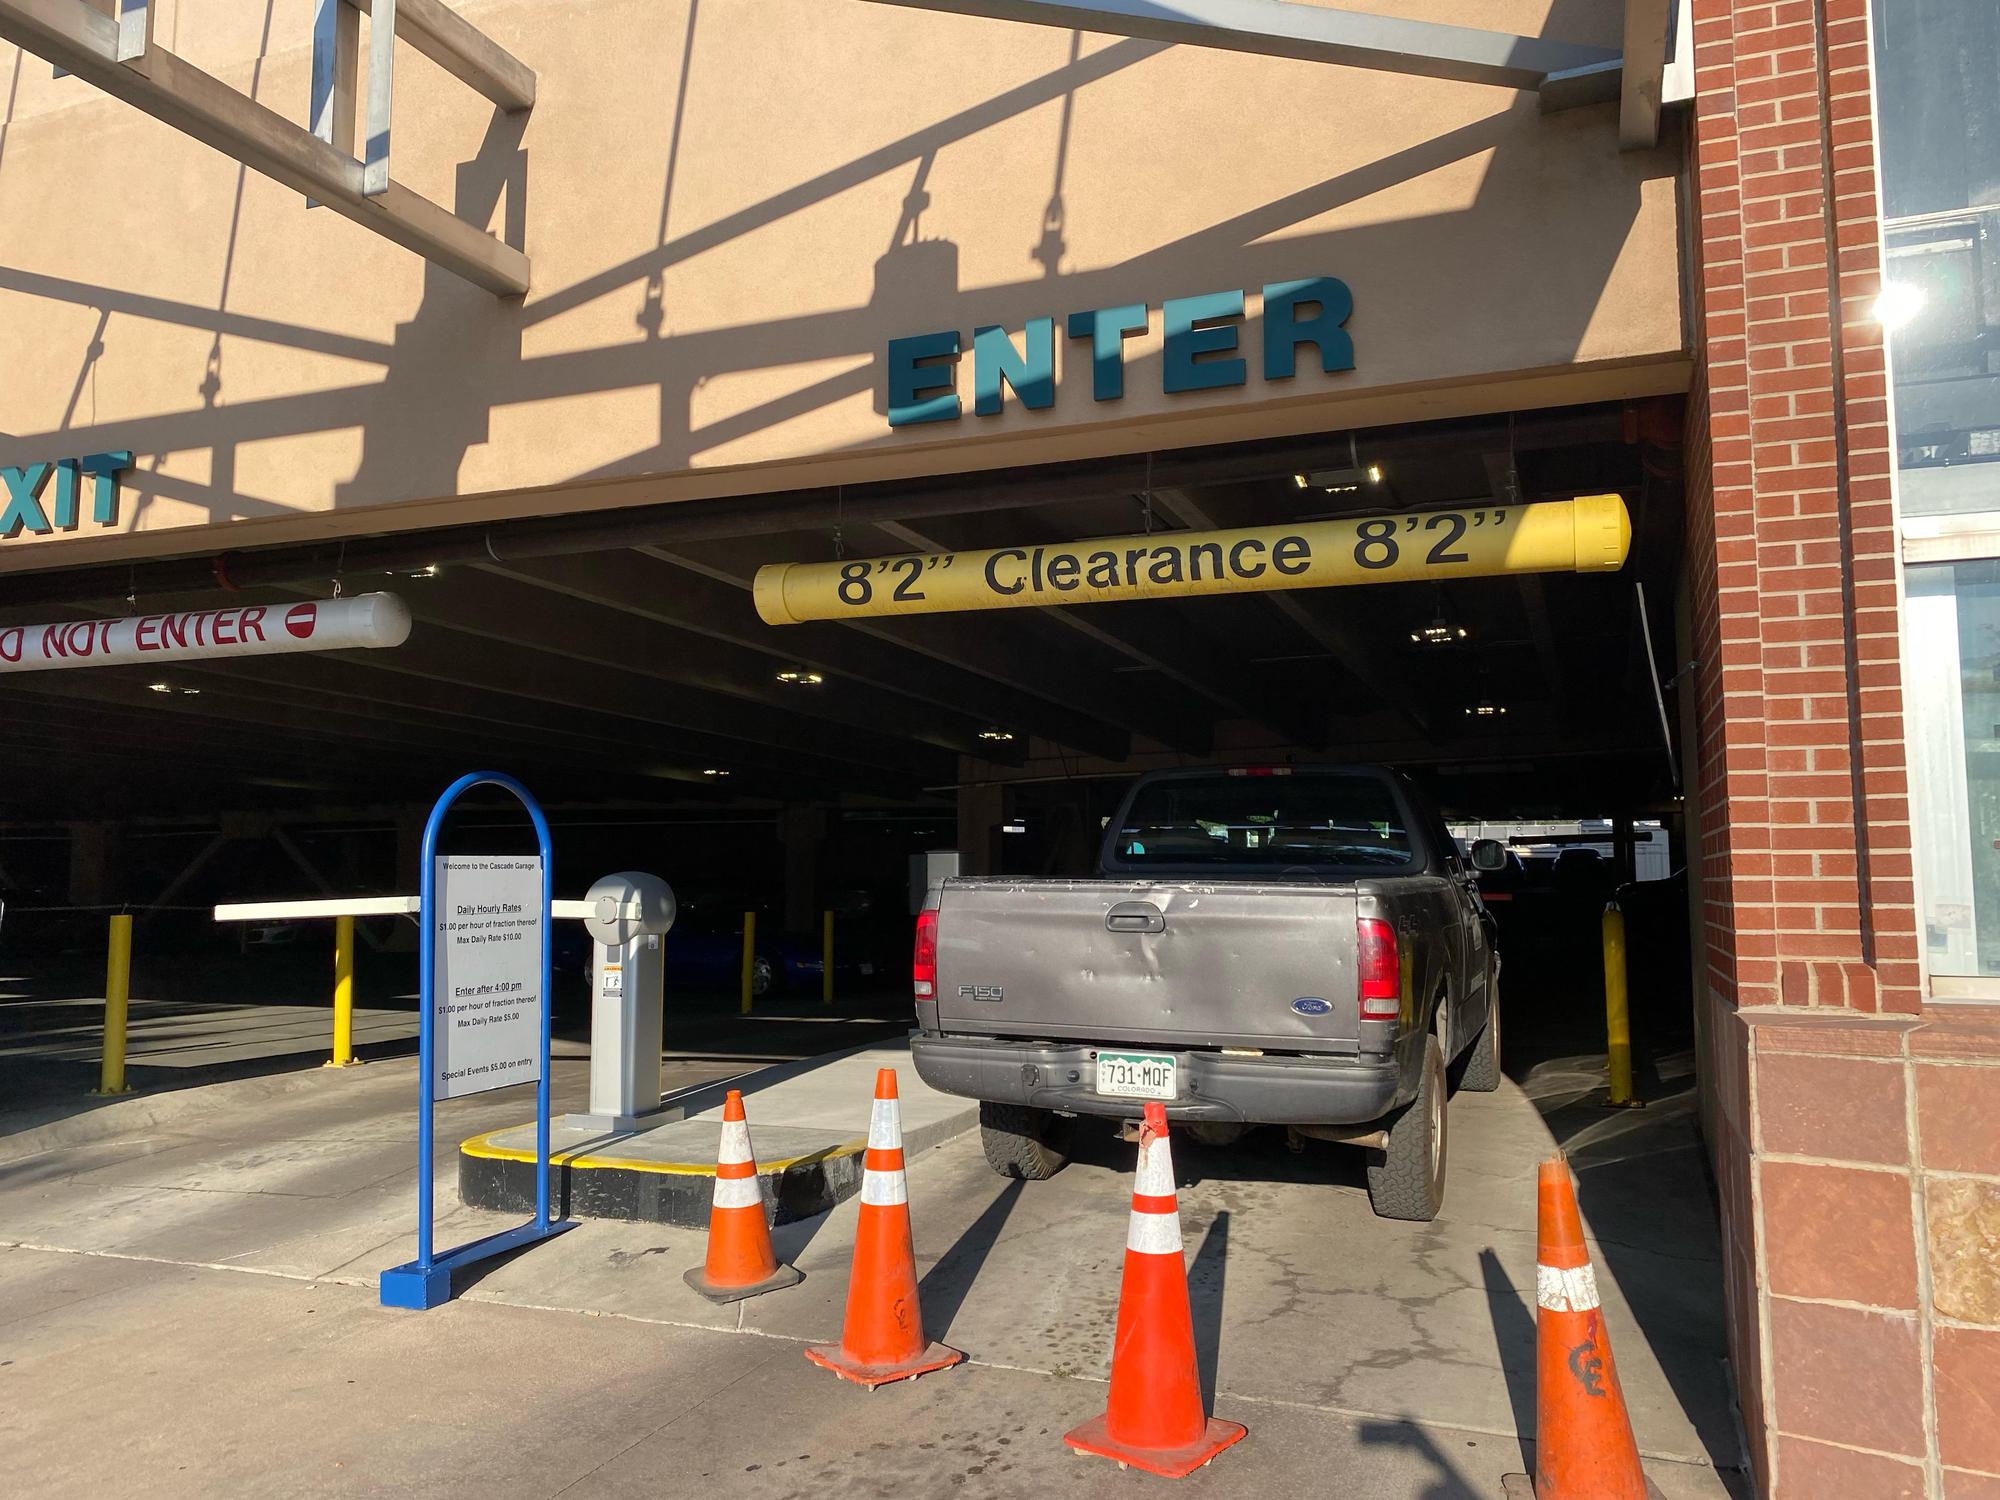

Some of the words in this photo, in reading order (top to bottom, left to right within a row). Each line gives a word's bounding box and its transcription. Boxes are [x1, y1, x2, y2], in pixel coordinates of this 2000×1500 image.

[888, 277, 1356, 427] ENTER
[984, 535, 1312, 596] Clearance
[42, 618, 125, 658] NOT
[135, 607, 267, 652] ENTER
[457, 905, 475, 916] Daily
[478, 904, 500, 914] Hourly
[503, 904, 521, 912] Rates
[440, 923, 456, 931] $1.00
[458, 923, 468, 931] per
[517, 918, 537, 926] thereof
[472, 936, 486, 944] Daily
[503, 933, 521, 941] $10.00
[456, 987, 475, 996] Enter
[477, 984, 493, 993] after
[495, 983, 510, 991] 4:00
[511, 982, 522, 991] pm
[438, 1006, 455, 1014] $1.00
[457, 1004, 467, 1013] per
[492, 998, 514, 1007] fraction
[516, 995, 536, 1004] thereof
[472, 1017, 487, 1026] Daily
[504, 1012, 519, 1021] $5.00
[442, 1069, 466, 1080] Special
[467, 1065, 489, 1076] Events
[490, 1062, 507, 1072] $5.00
[517, 1058, 532, 1066] entry
[1118, 1086, 1156, 1094] COLORADO
